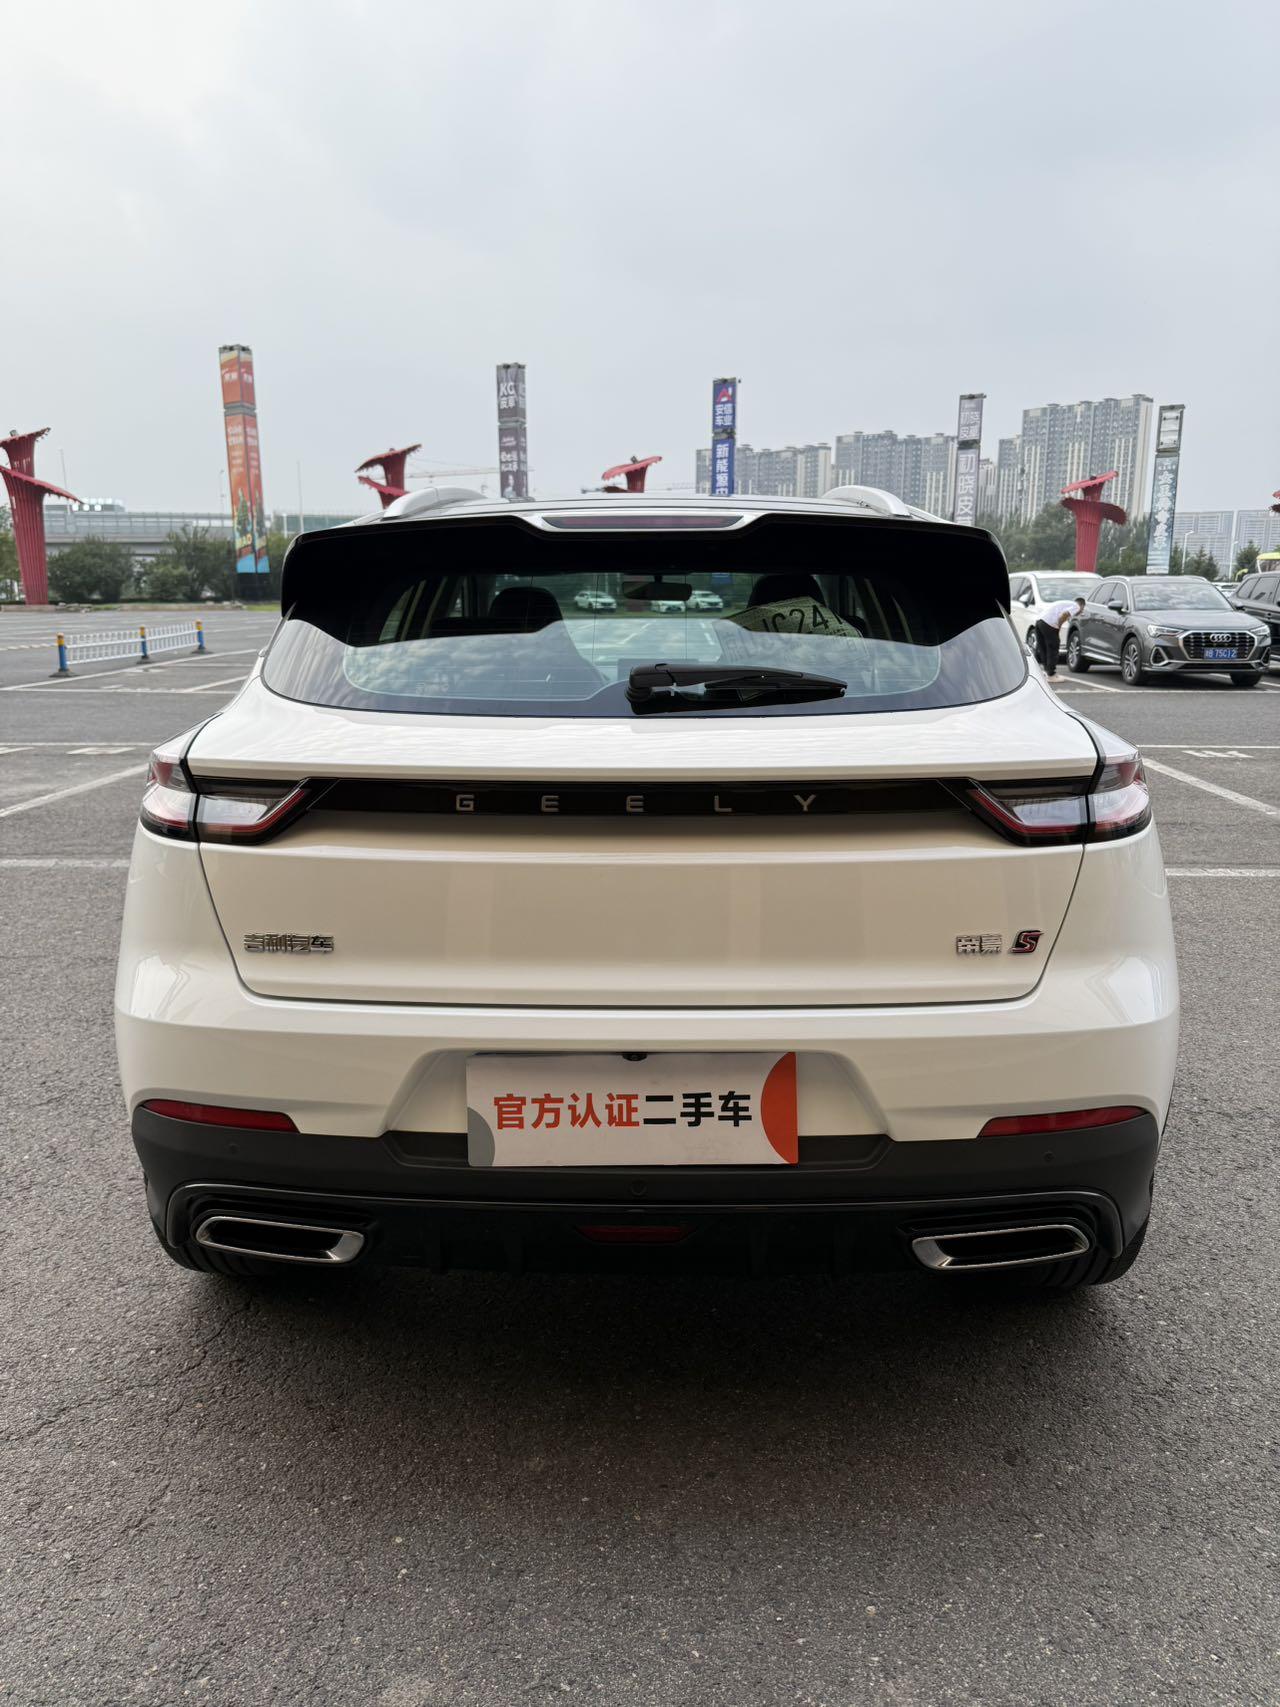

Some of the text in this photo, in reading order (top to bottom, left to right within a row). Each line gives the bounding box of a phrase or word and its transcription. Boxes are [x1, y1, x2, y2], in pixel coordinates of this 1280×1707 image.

[455, 794, 816, 812] GEELY
[493, 1091, 753, 1130] 官方认证二手车
